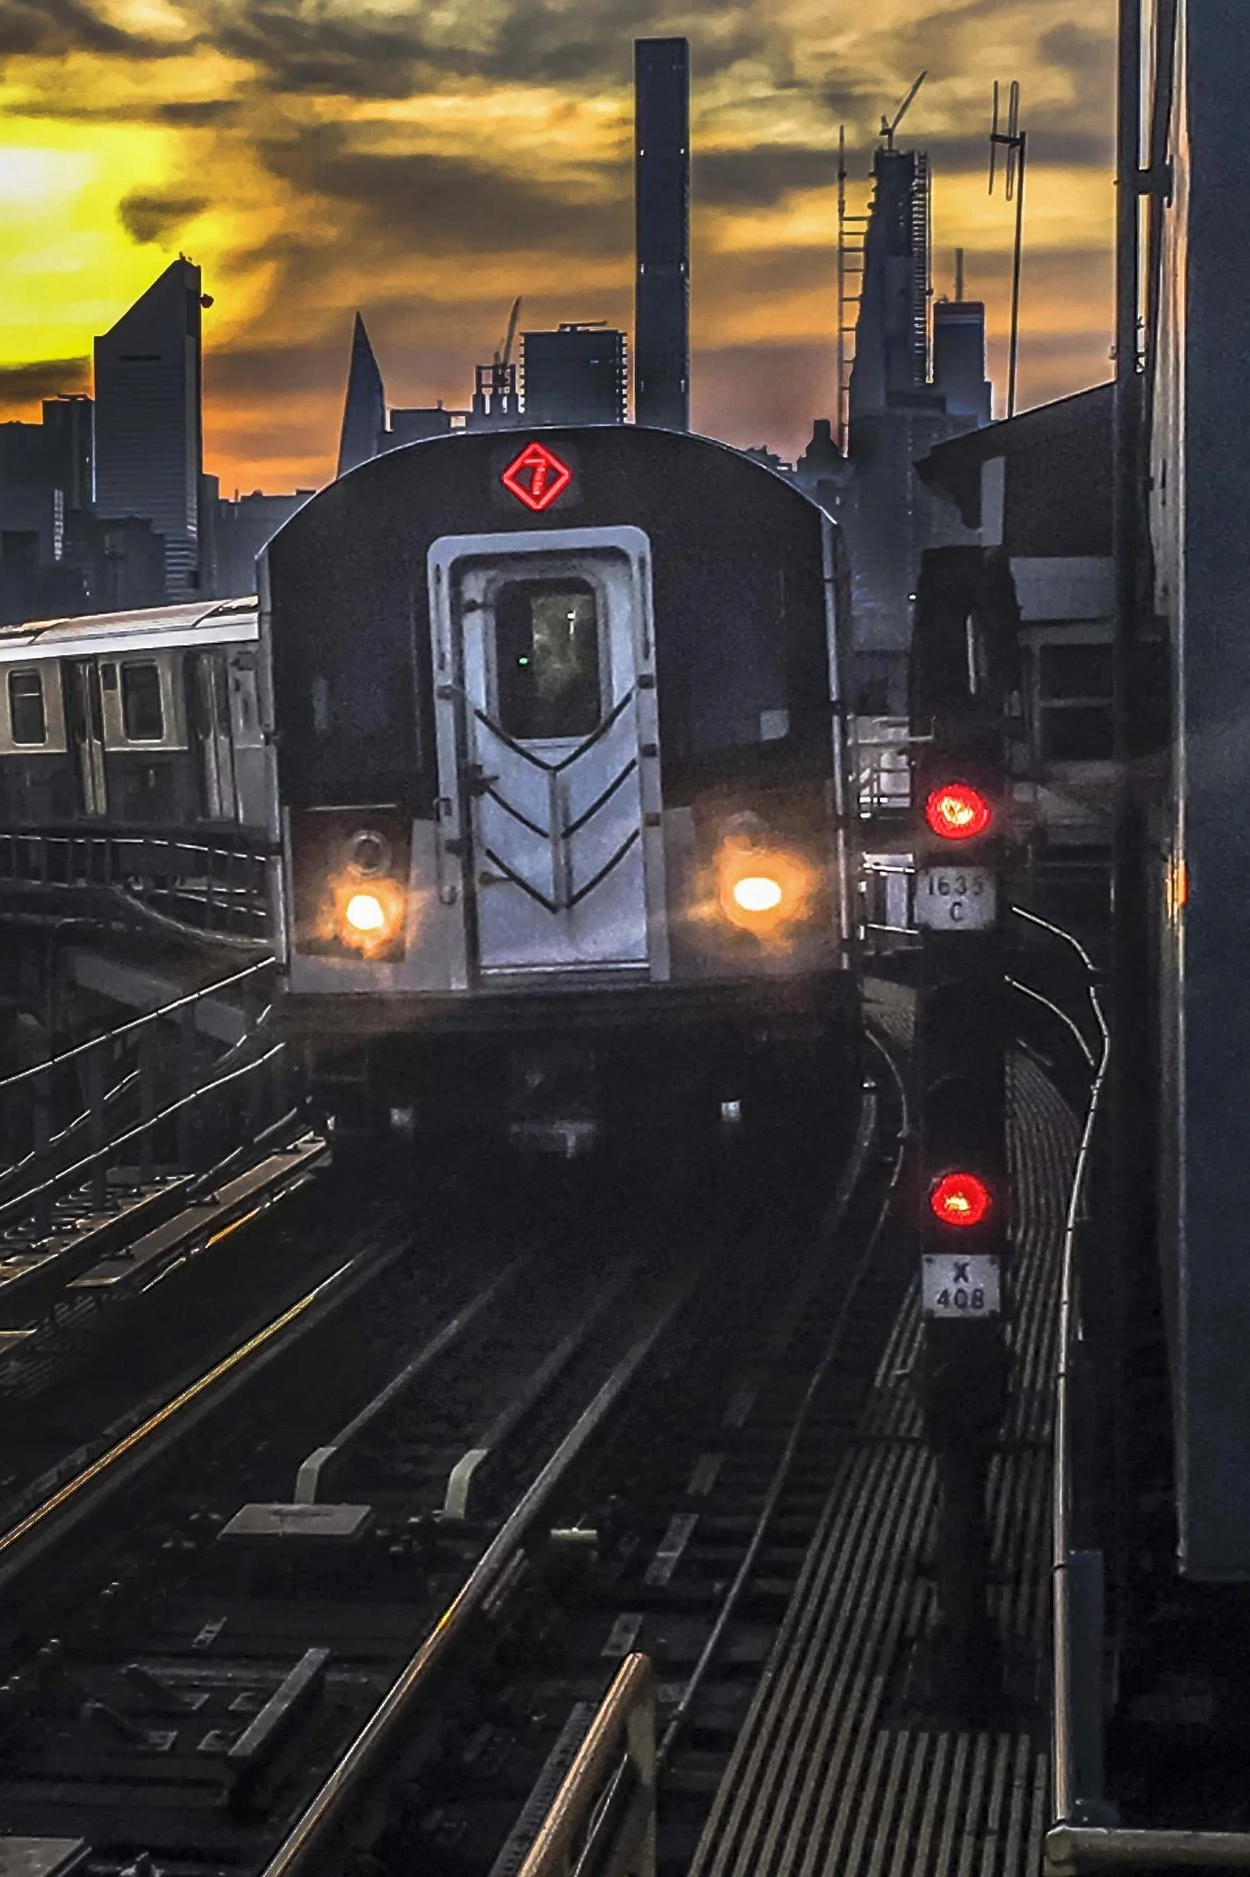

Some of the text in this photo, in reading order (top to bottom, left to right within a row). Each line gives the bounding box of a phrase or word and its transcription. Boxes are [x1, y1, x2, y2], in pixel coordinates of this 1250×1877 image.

[523, 458, 546, 496] 7
[950, 901, 963, 922] C
[953, 1261, 970, 1284] X
[936, 1288, 985, 1310] 408
